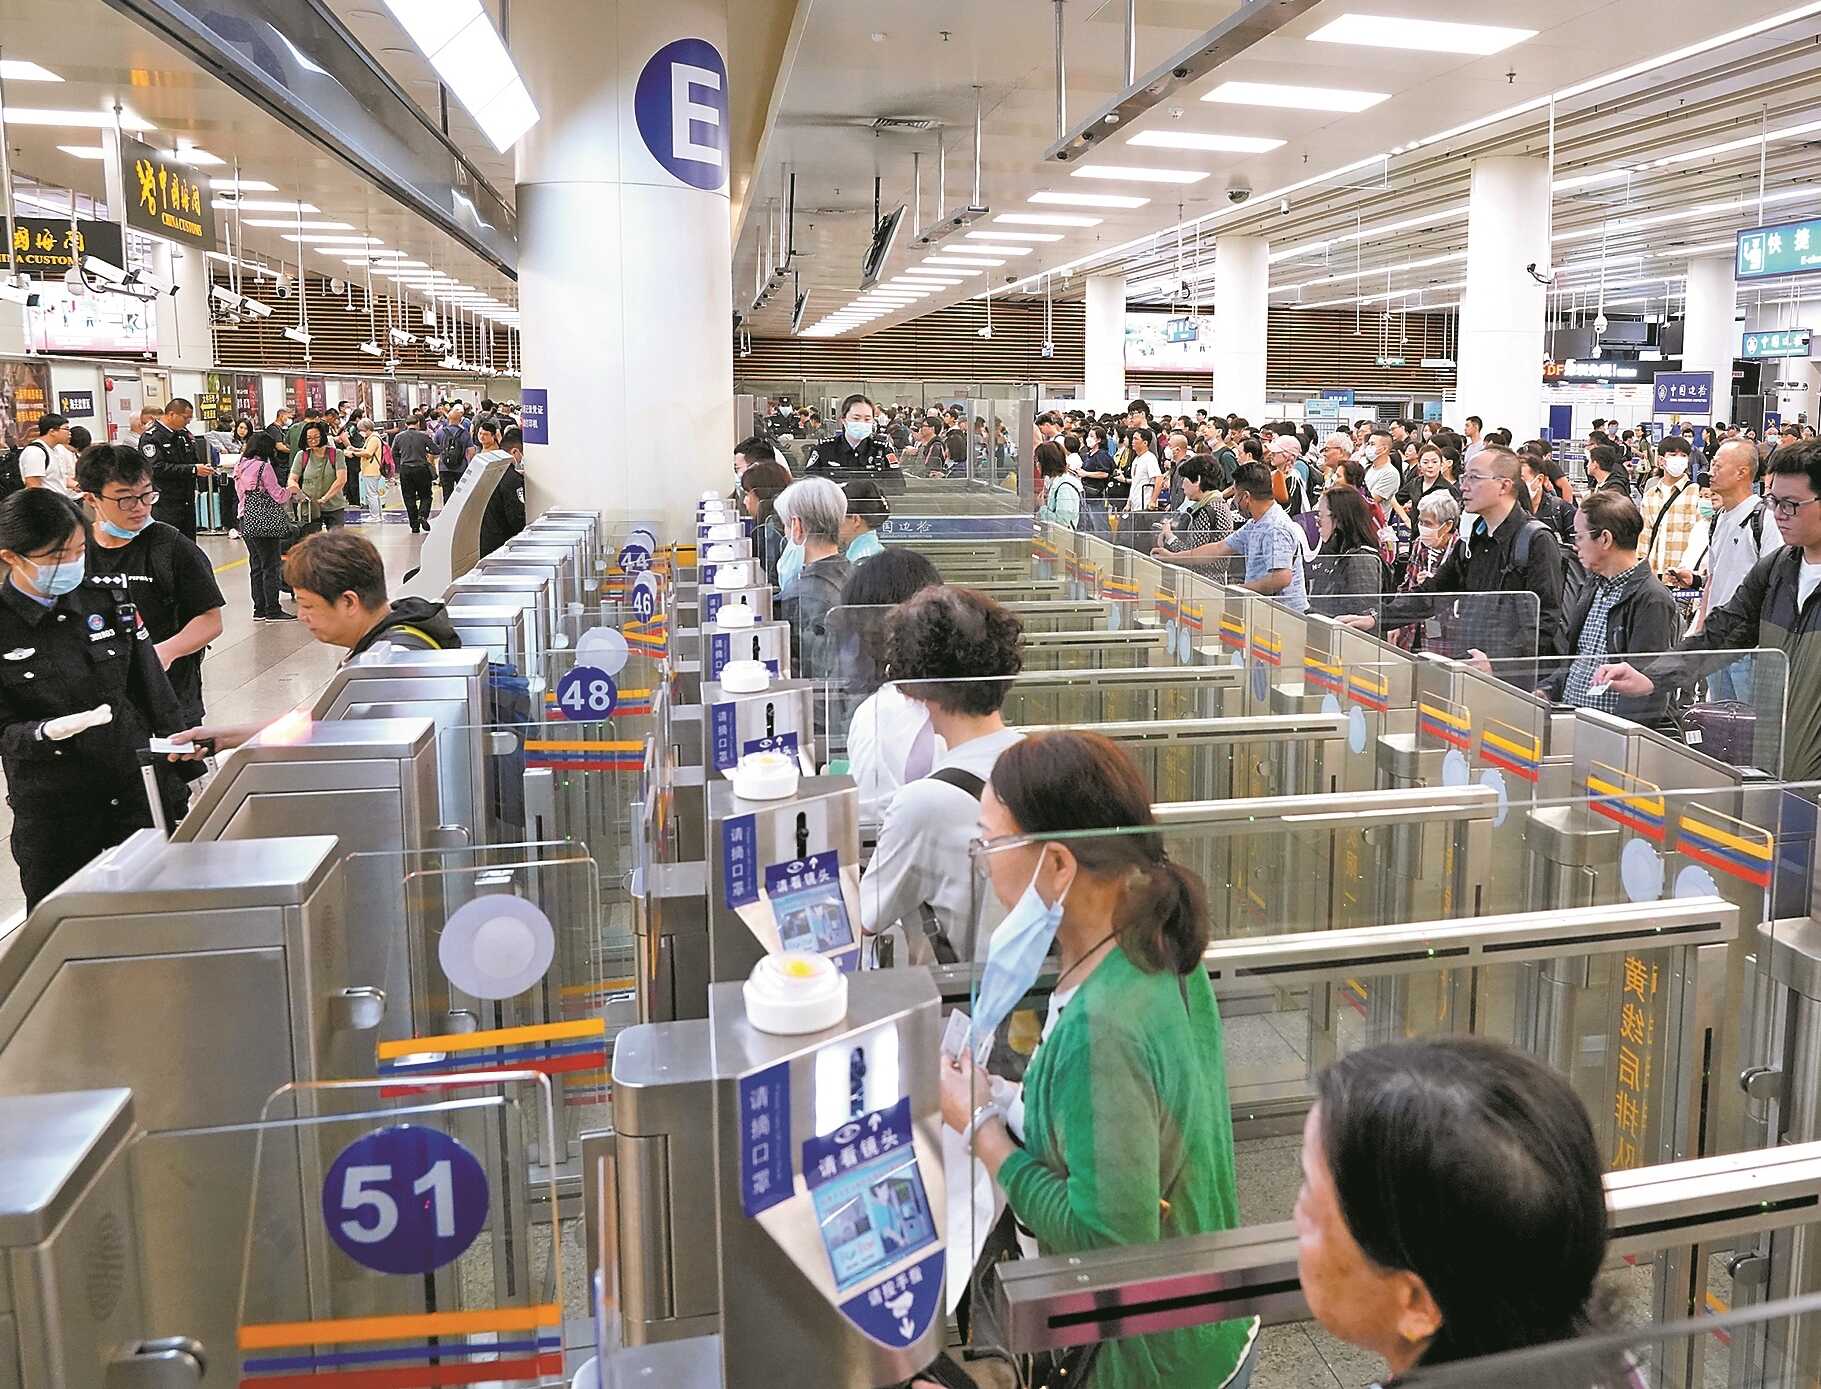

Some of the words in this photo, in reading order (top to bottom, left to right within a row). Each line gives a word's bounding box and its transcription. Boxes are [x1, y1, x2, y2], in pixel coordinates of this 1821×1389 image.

[671, 62, 722, 166] E
[620, 552, 649, 568] 44
[633, 592, 651, 615] 46
[561, 679, 610, 711] 48
[731, 827, 745, 897] 请摘口罩
[775, 868, 831, 893] 请看镜头
[750, 1085, 771, 1195] 请摘口罩
[818, 1127, 900, 1179] 请看镜头
[340, 1159, 456, 1244] 51
